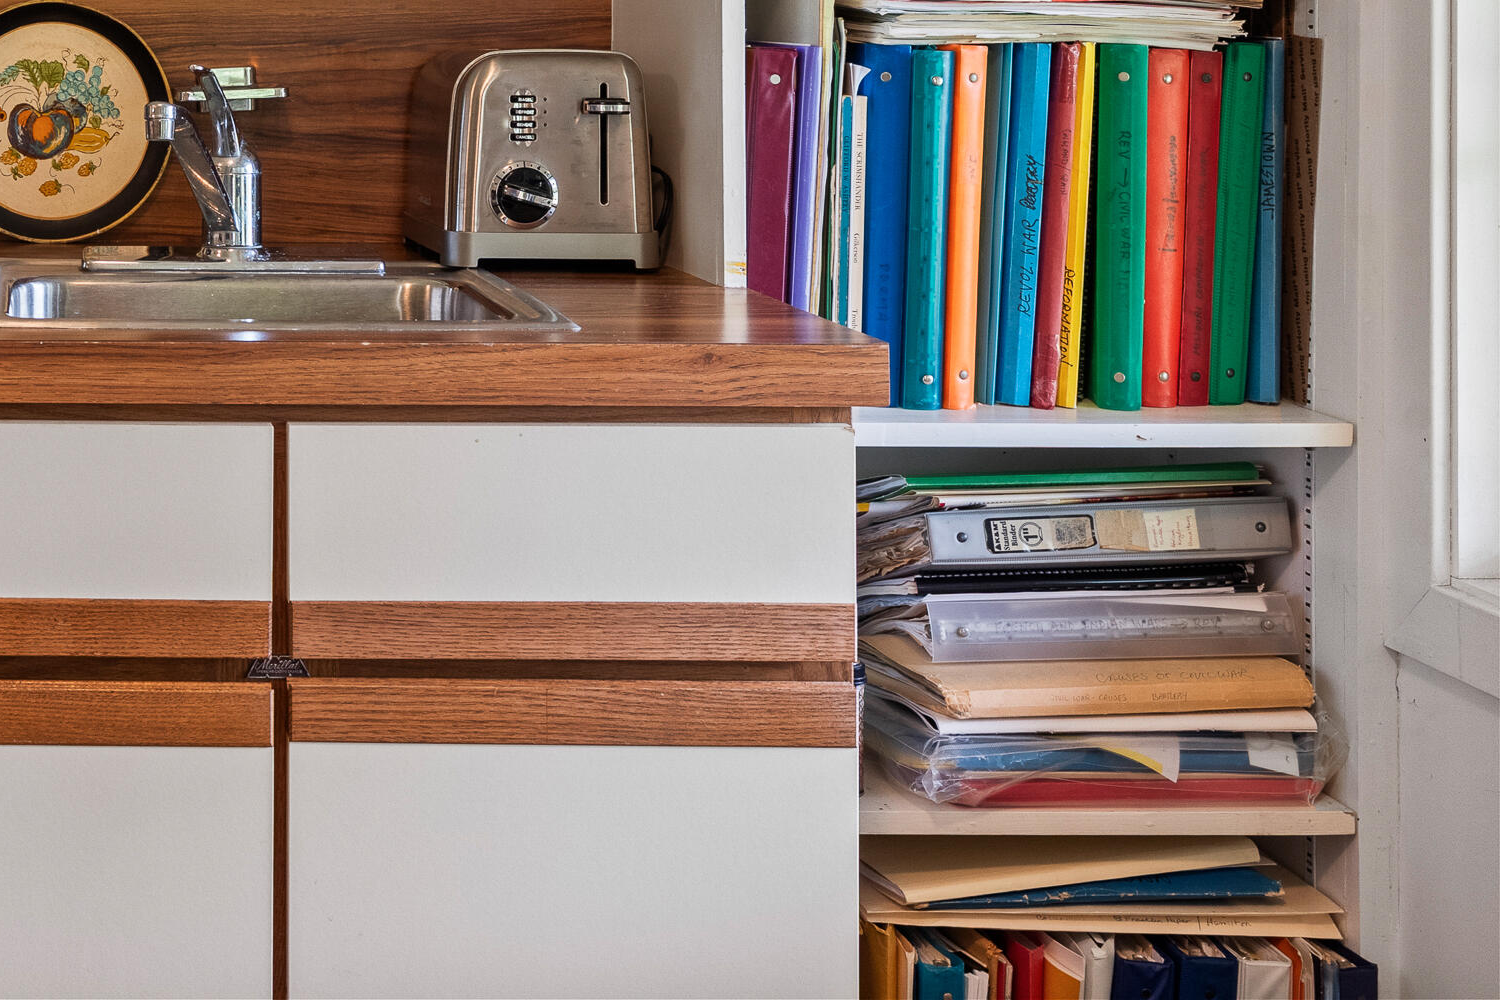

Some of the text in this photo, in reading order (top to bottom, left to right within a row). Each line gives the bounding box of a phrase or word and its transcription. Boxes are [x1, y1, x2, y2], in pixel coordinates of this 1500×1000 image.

[1118, 130, 1132, 160] REV
[1302, 114, 1312, 155] Priority
[854, 151, 863, 210] SCRIMSHANDER
[1261, 131, 1275, 221] JAMESTOWN
[1118, 191, 1131, 223] CIVIL
[1020, 217, 1040, 257] WAR
[1120, 227, 1131, 260] WAR
[1299, 212, 1308, 254] Priority
[1060, 266, 1076, 368] REFORMATION
[1000, 521, 1011, 551] Standard
[1010, 524, 1019, 547] Binder
[1023, 527, 1039, 542] 1"
[255, 659, 301, 670] Merillat
[1095, 671, 1149, 683] CAUSES
[1179, 671, 1214, 680] CIVIL
[1215, 667, 1249, 679] WAR
